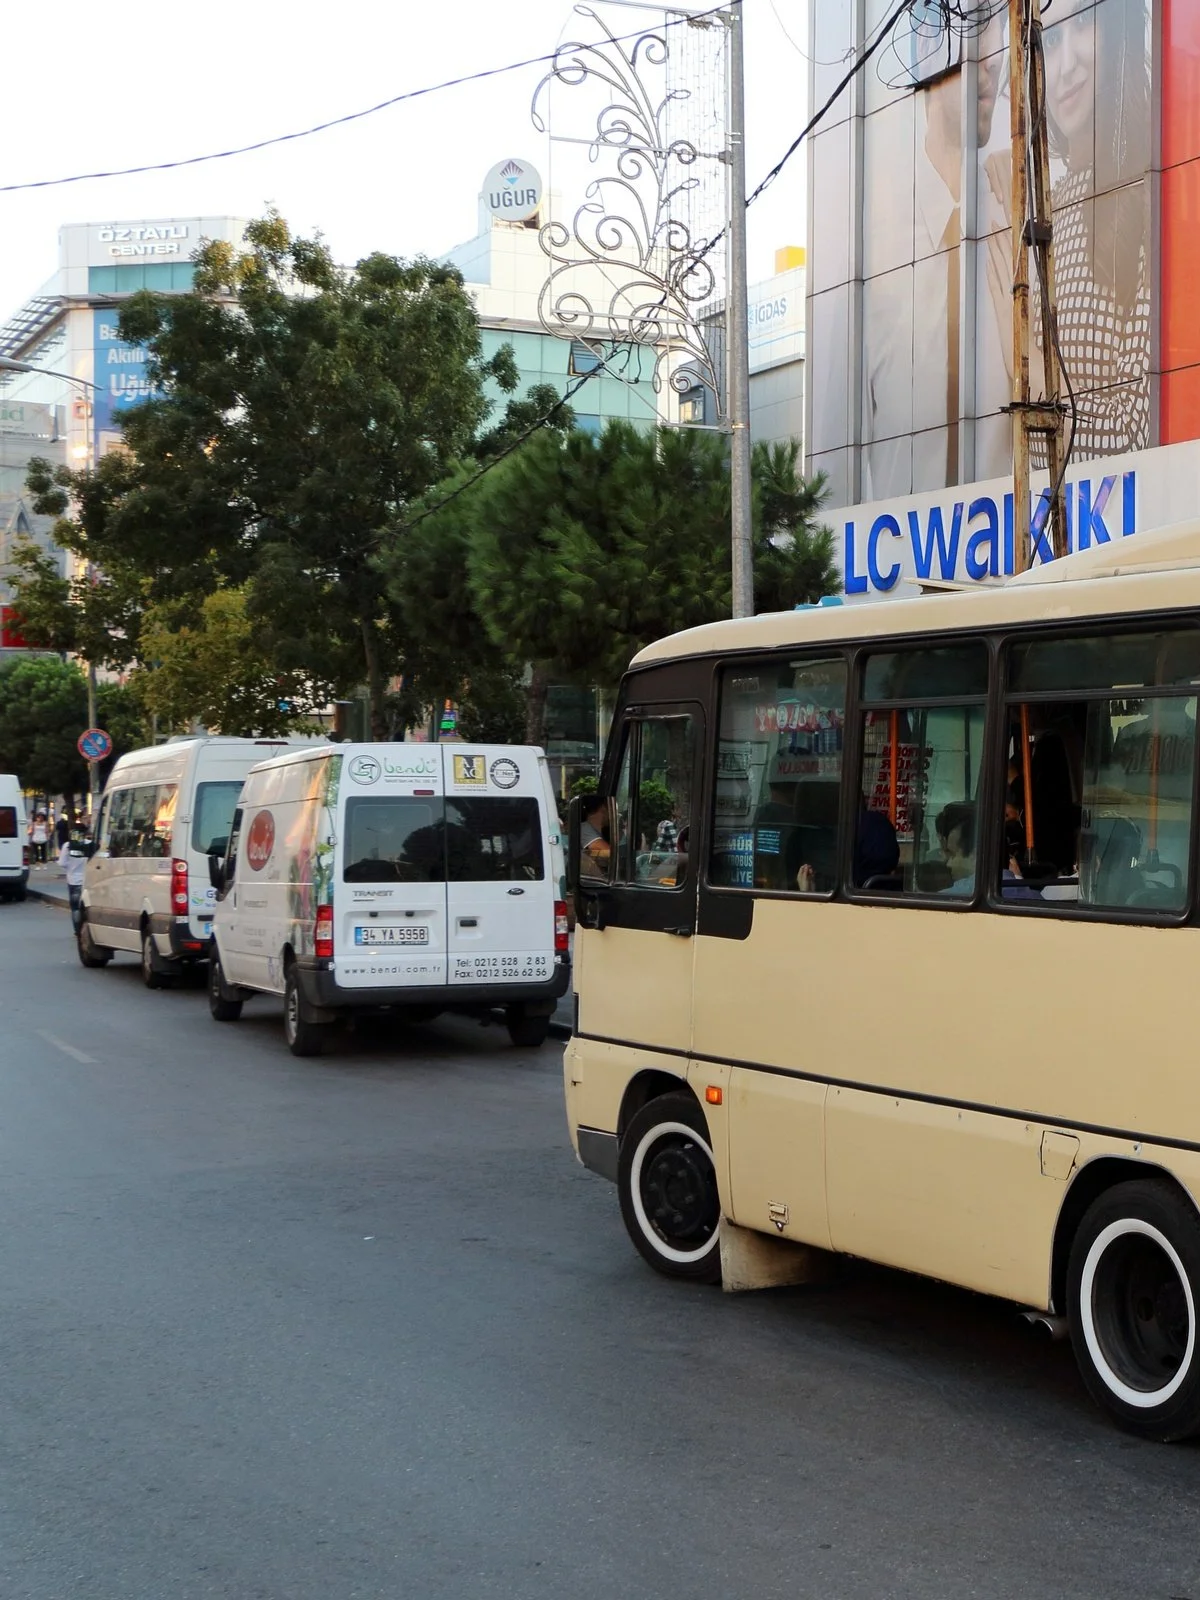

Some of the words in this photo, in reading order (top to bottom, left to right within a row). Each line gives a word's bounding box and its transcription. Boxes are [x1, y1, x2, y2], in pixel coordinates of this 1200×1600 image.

[489, 186, 537, 209] UĞUR
[109, 243, 180, 257] CENTER
[845, 514, 903, 595] LC
[363, 929, 376, 940] 34
[382, 929, 395, 941] YA
[399, 928, 426, 940] 5958
[474, 957, 498, 967] 0212
[501, 957, 518, 966] 528
[476, 969, 499, 978] 0212
[502, 968, 519, 977] 526
[521, 968, 533, 977] 62
